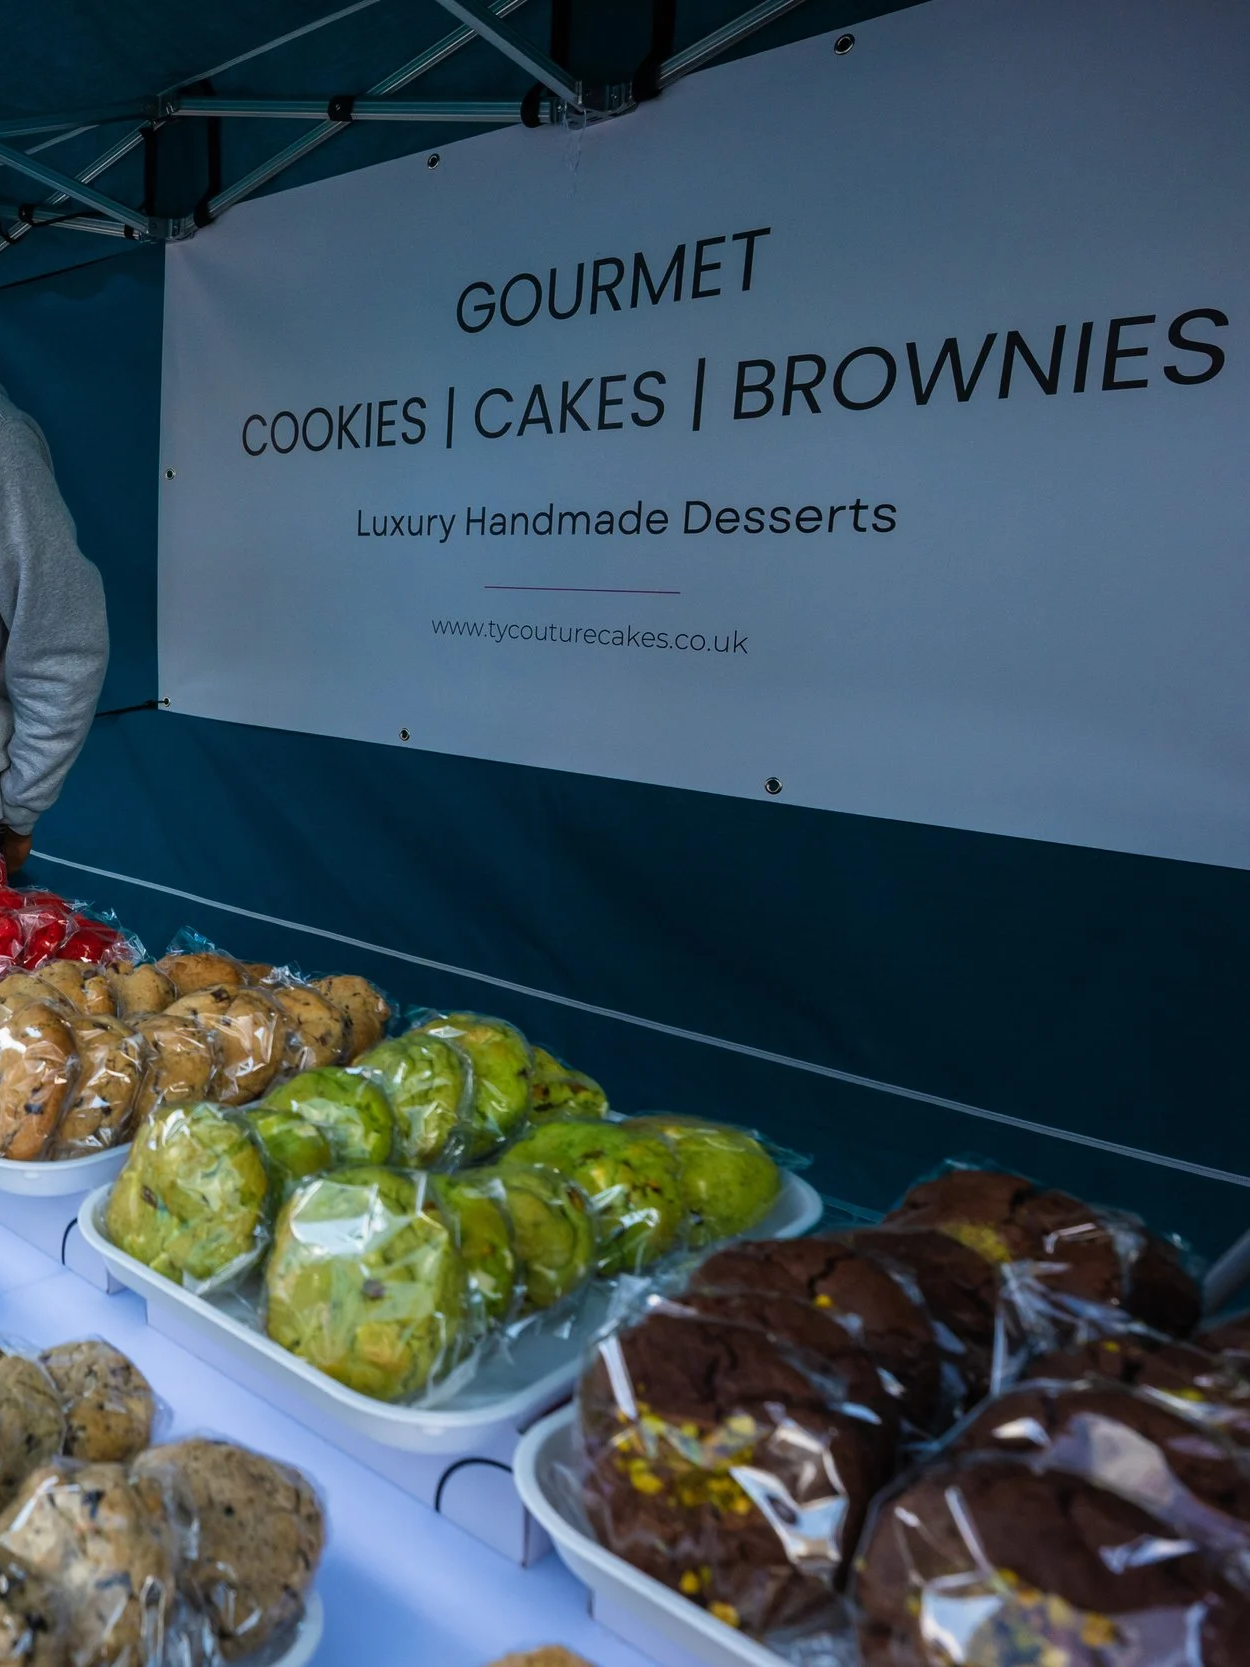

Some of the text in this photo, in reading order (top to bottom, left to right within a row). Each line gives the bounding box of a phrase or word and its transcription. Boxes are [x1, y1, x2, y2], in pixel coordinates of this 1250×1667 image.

[455, 226, 772, 335] GOURMET
[241, 396, 427, 457] COOKIES
[474, 370, 667, 440] CAKES
[732, 307, 1230, 421] BROWNIES
[357, 498, 897, 544] Luxury Handmade Desserts
[431, 619, 749, 655] www.tycouturecakes.co.uk
